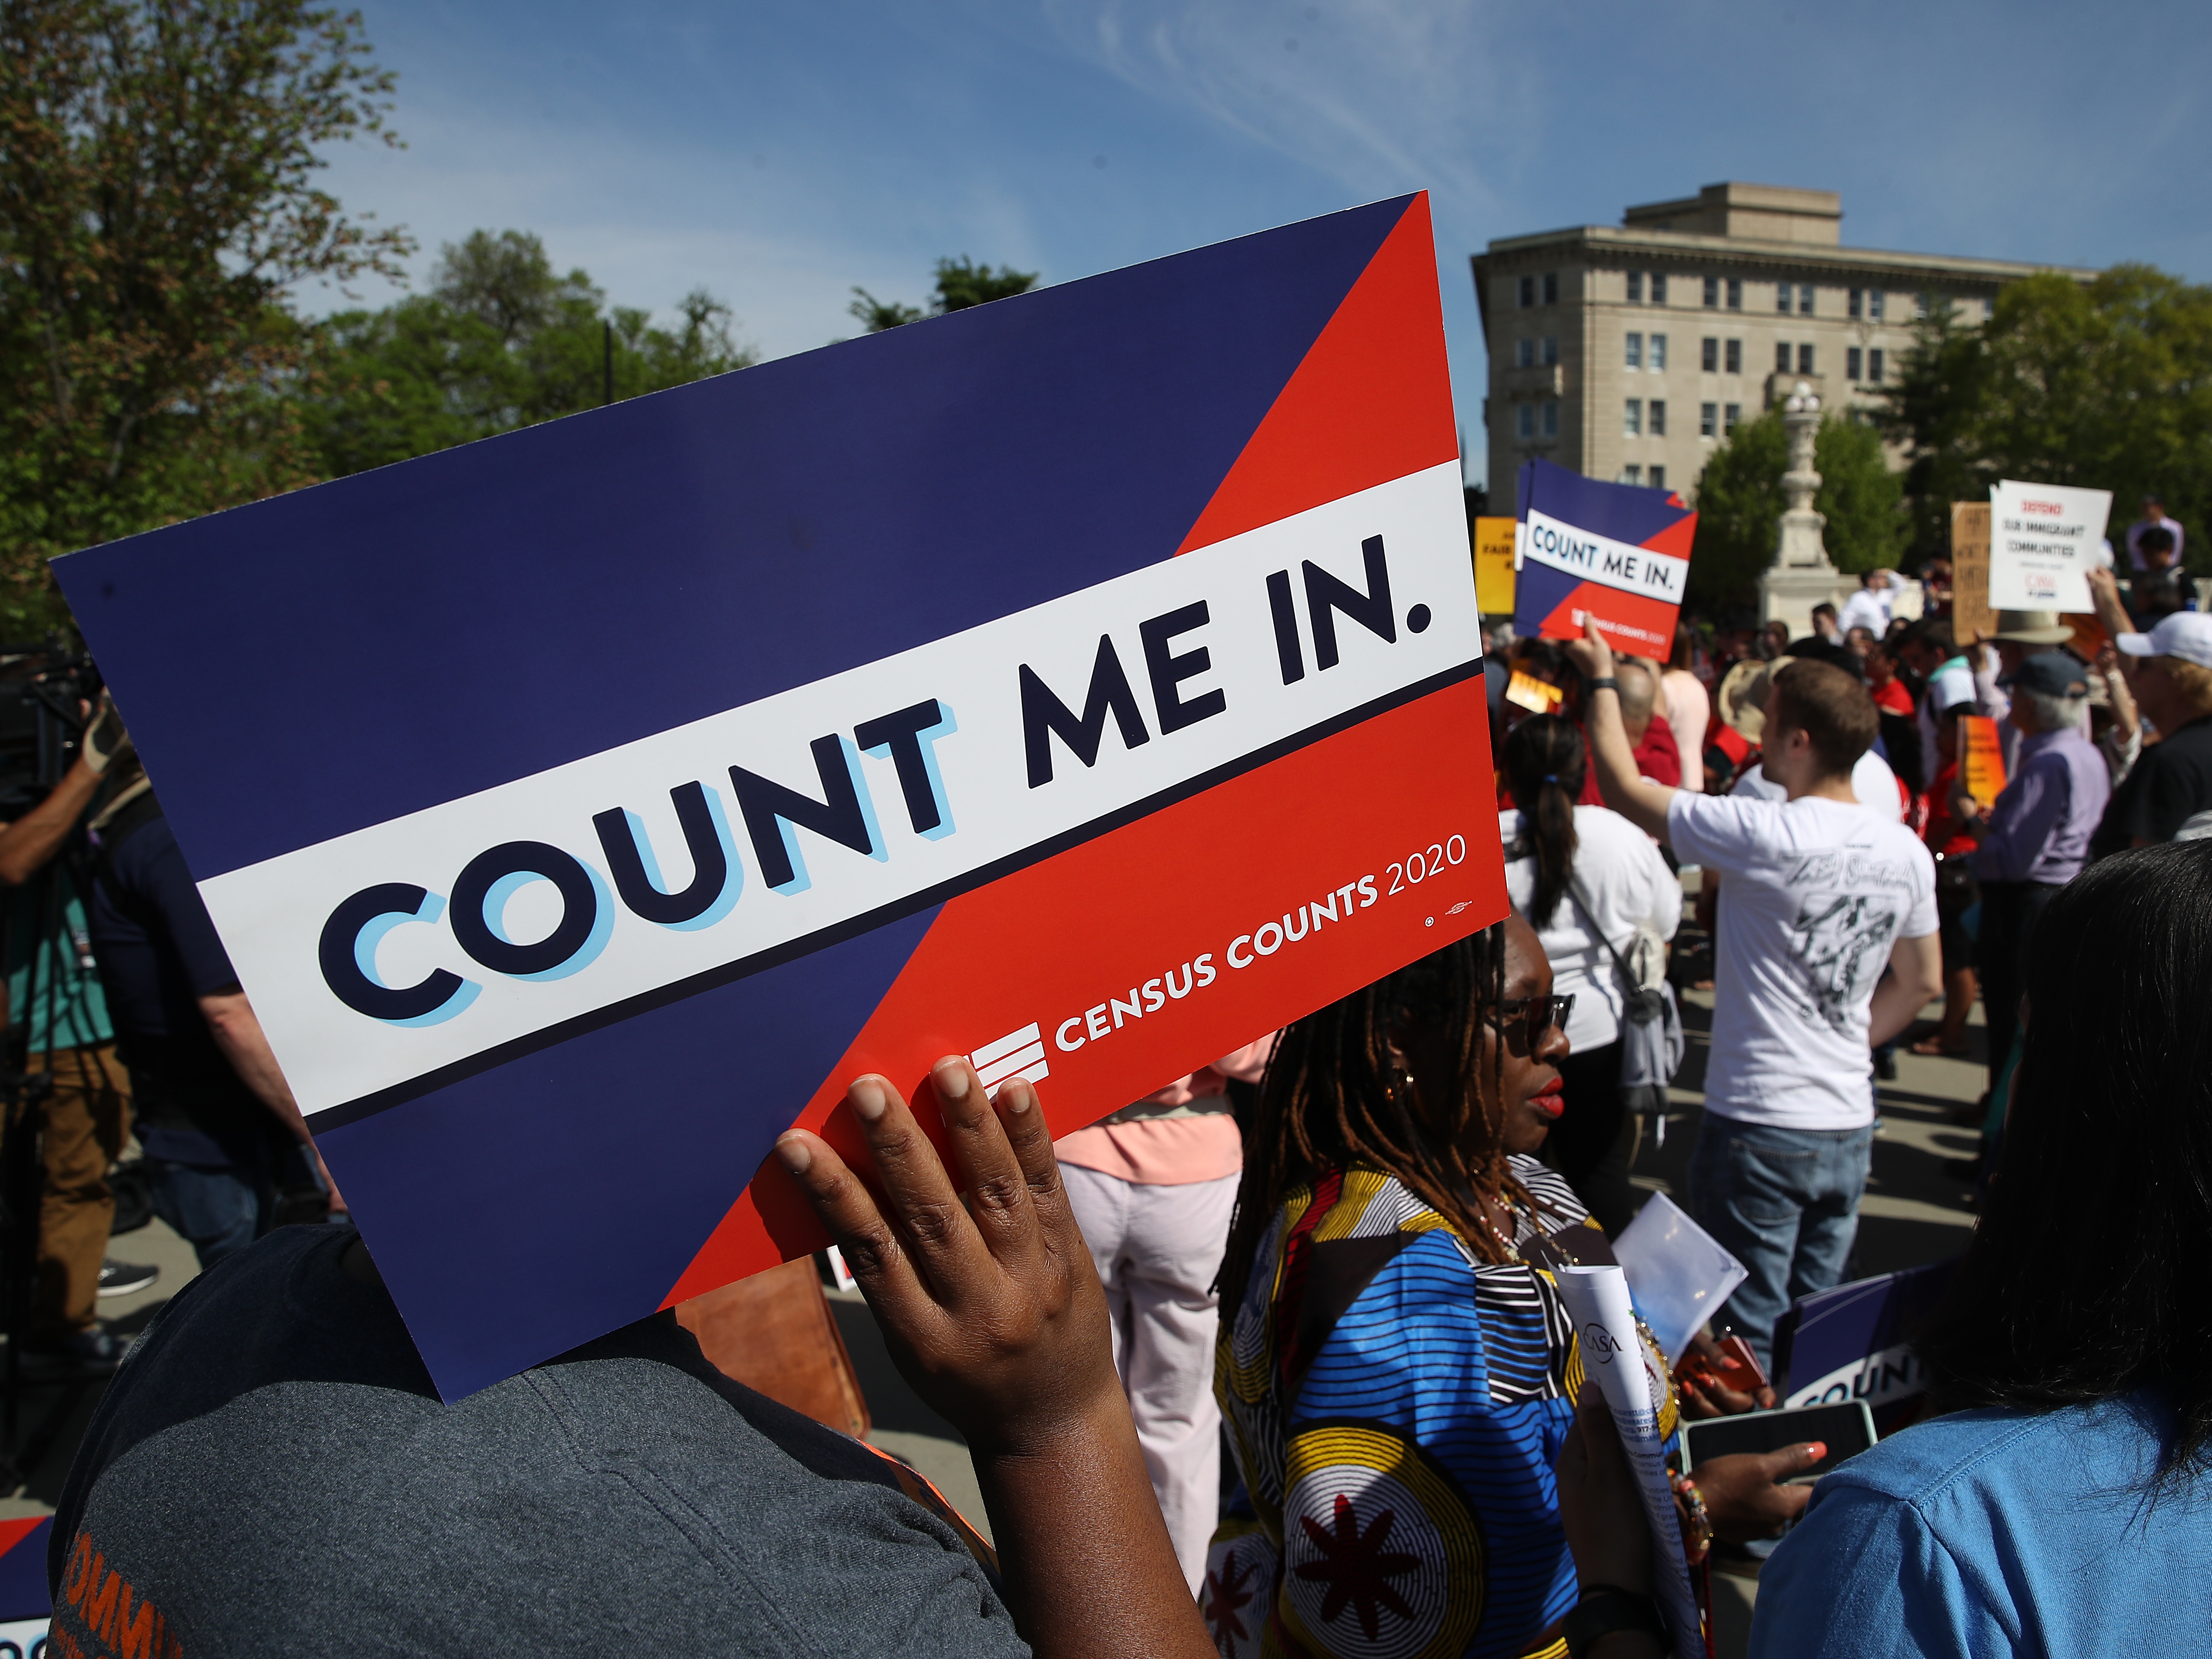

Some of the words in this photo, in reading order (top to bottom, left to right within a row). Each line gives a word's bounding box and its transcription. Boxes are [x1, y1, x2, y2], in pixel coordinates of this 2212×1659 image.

[1534, 525, 1597, 569] COUNT
[1603, 551, 1637, 579] ME
[1645, 562, 1673, 590] IN.
[319, 699, 957, 1027] COUNT
[1019, 600, 1225, 788] ME
[1266, 535, 1431, 685] IN.
[1055, 954, 1216, 1052] CENSUS
[1226, 875, 1378, 968] COUNTS
[1386, 834, 1465, 896] 2020
[1584, 1332, 1623, 1353] CASA
